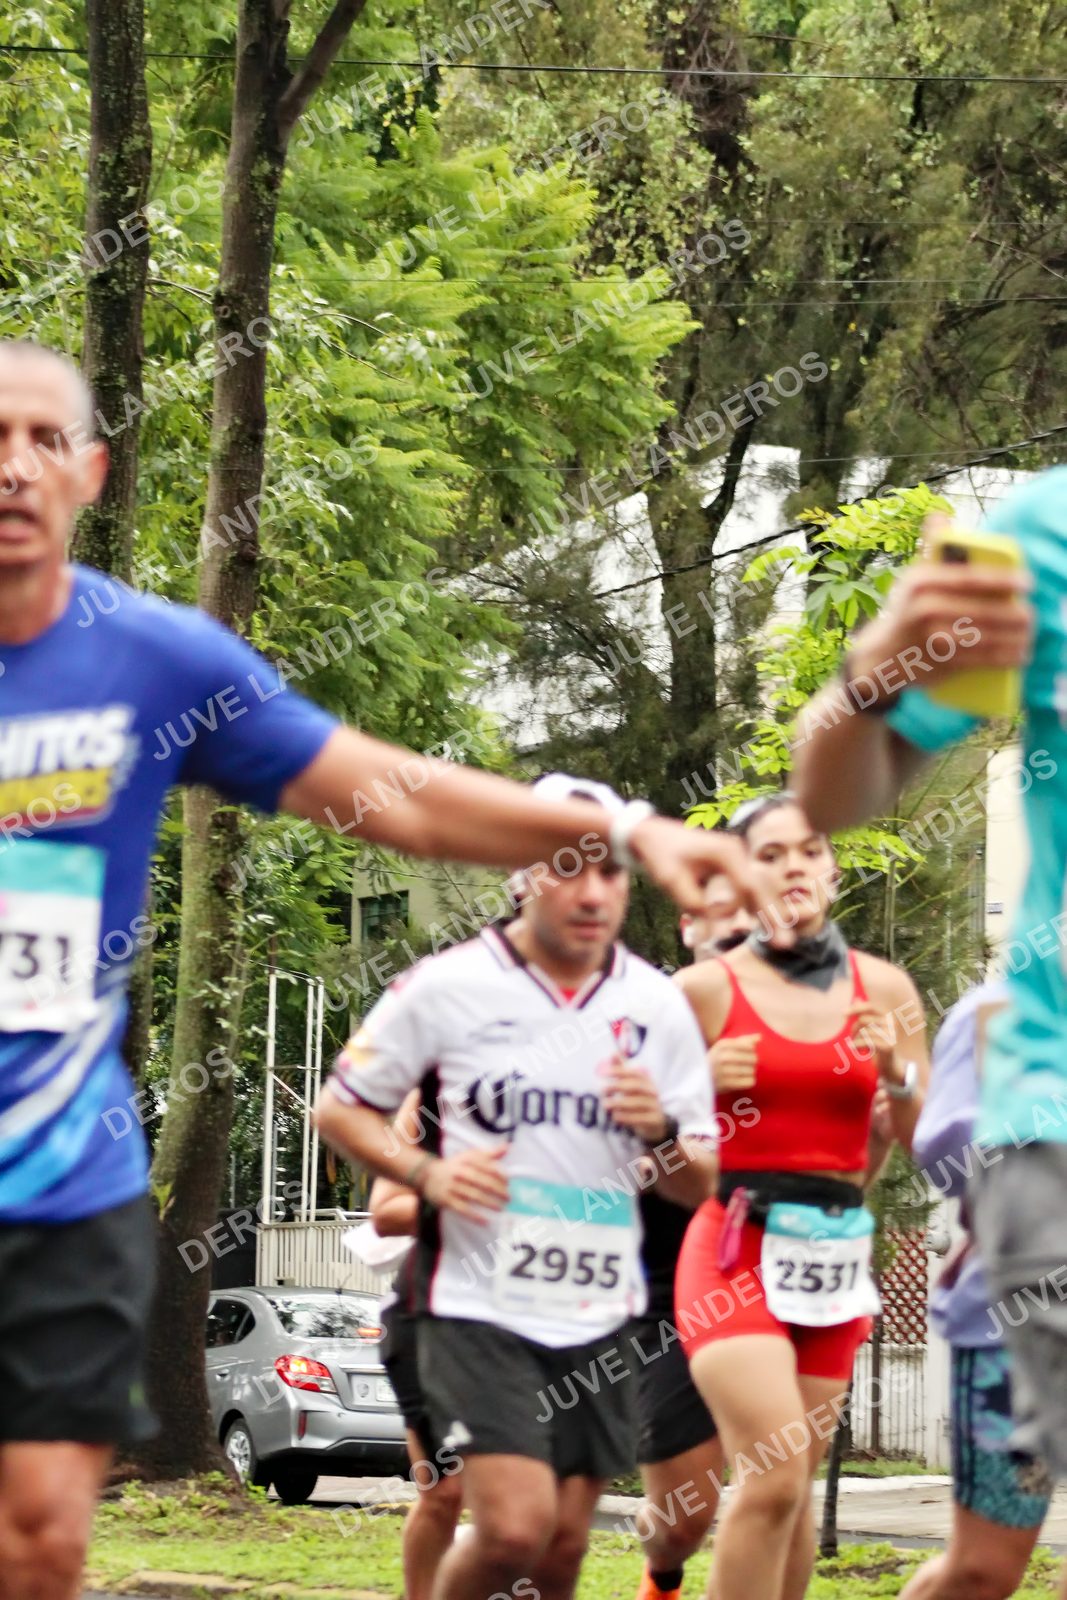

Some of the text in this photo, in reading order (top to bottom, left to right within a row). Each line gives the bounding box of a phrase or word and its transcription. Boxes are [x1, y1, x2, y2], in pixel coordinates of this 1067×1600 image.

[0, 931, 70, 985] 31
[468, 1070, 636, 1142] Coro
[509, 1243, 621, 1289] 2955
[775, 1259, 859, 1293] 2531
